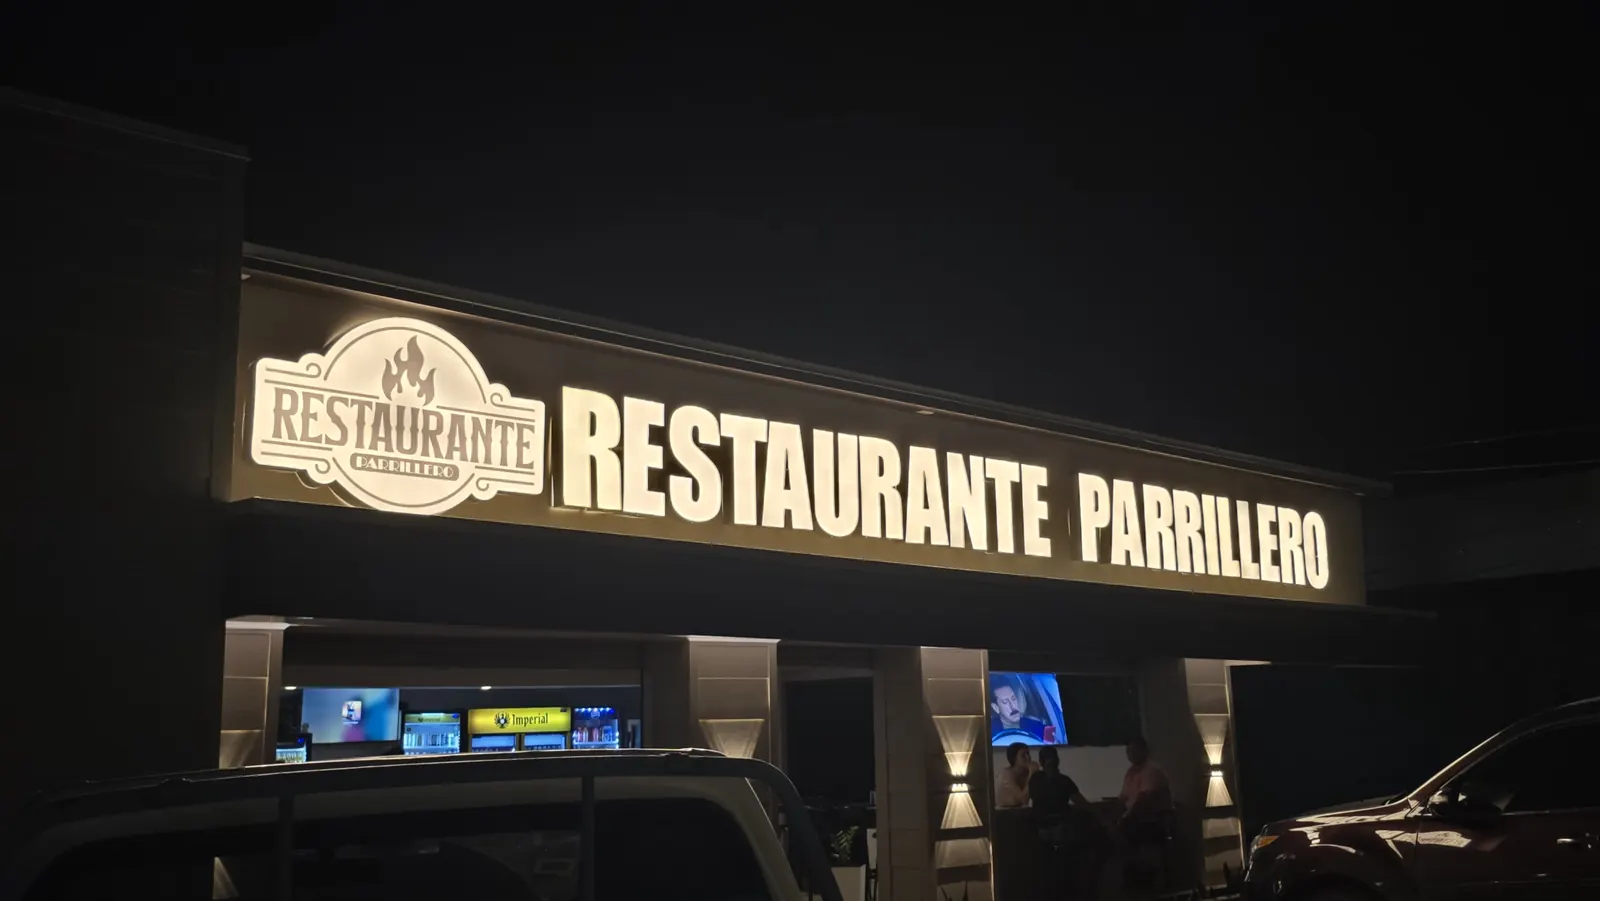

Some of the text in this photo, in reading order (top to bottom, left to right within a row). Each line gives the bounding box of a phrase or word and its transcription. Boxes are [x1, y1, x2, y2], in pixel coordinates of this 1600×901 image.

[272, 387, 535, 469] RESTAURANTE
[356, 456, 454, 478] PARRILLERO
[562, 386, 1330, 590] RESTAURANTE PARRILLERO
[512, 713, 549, 727] Imperial
